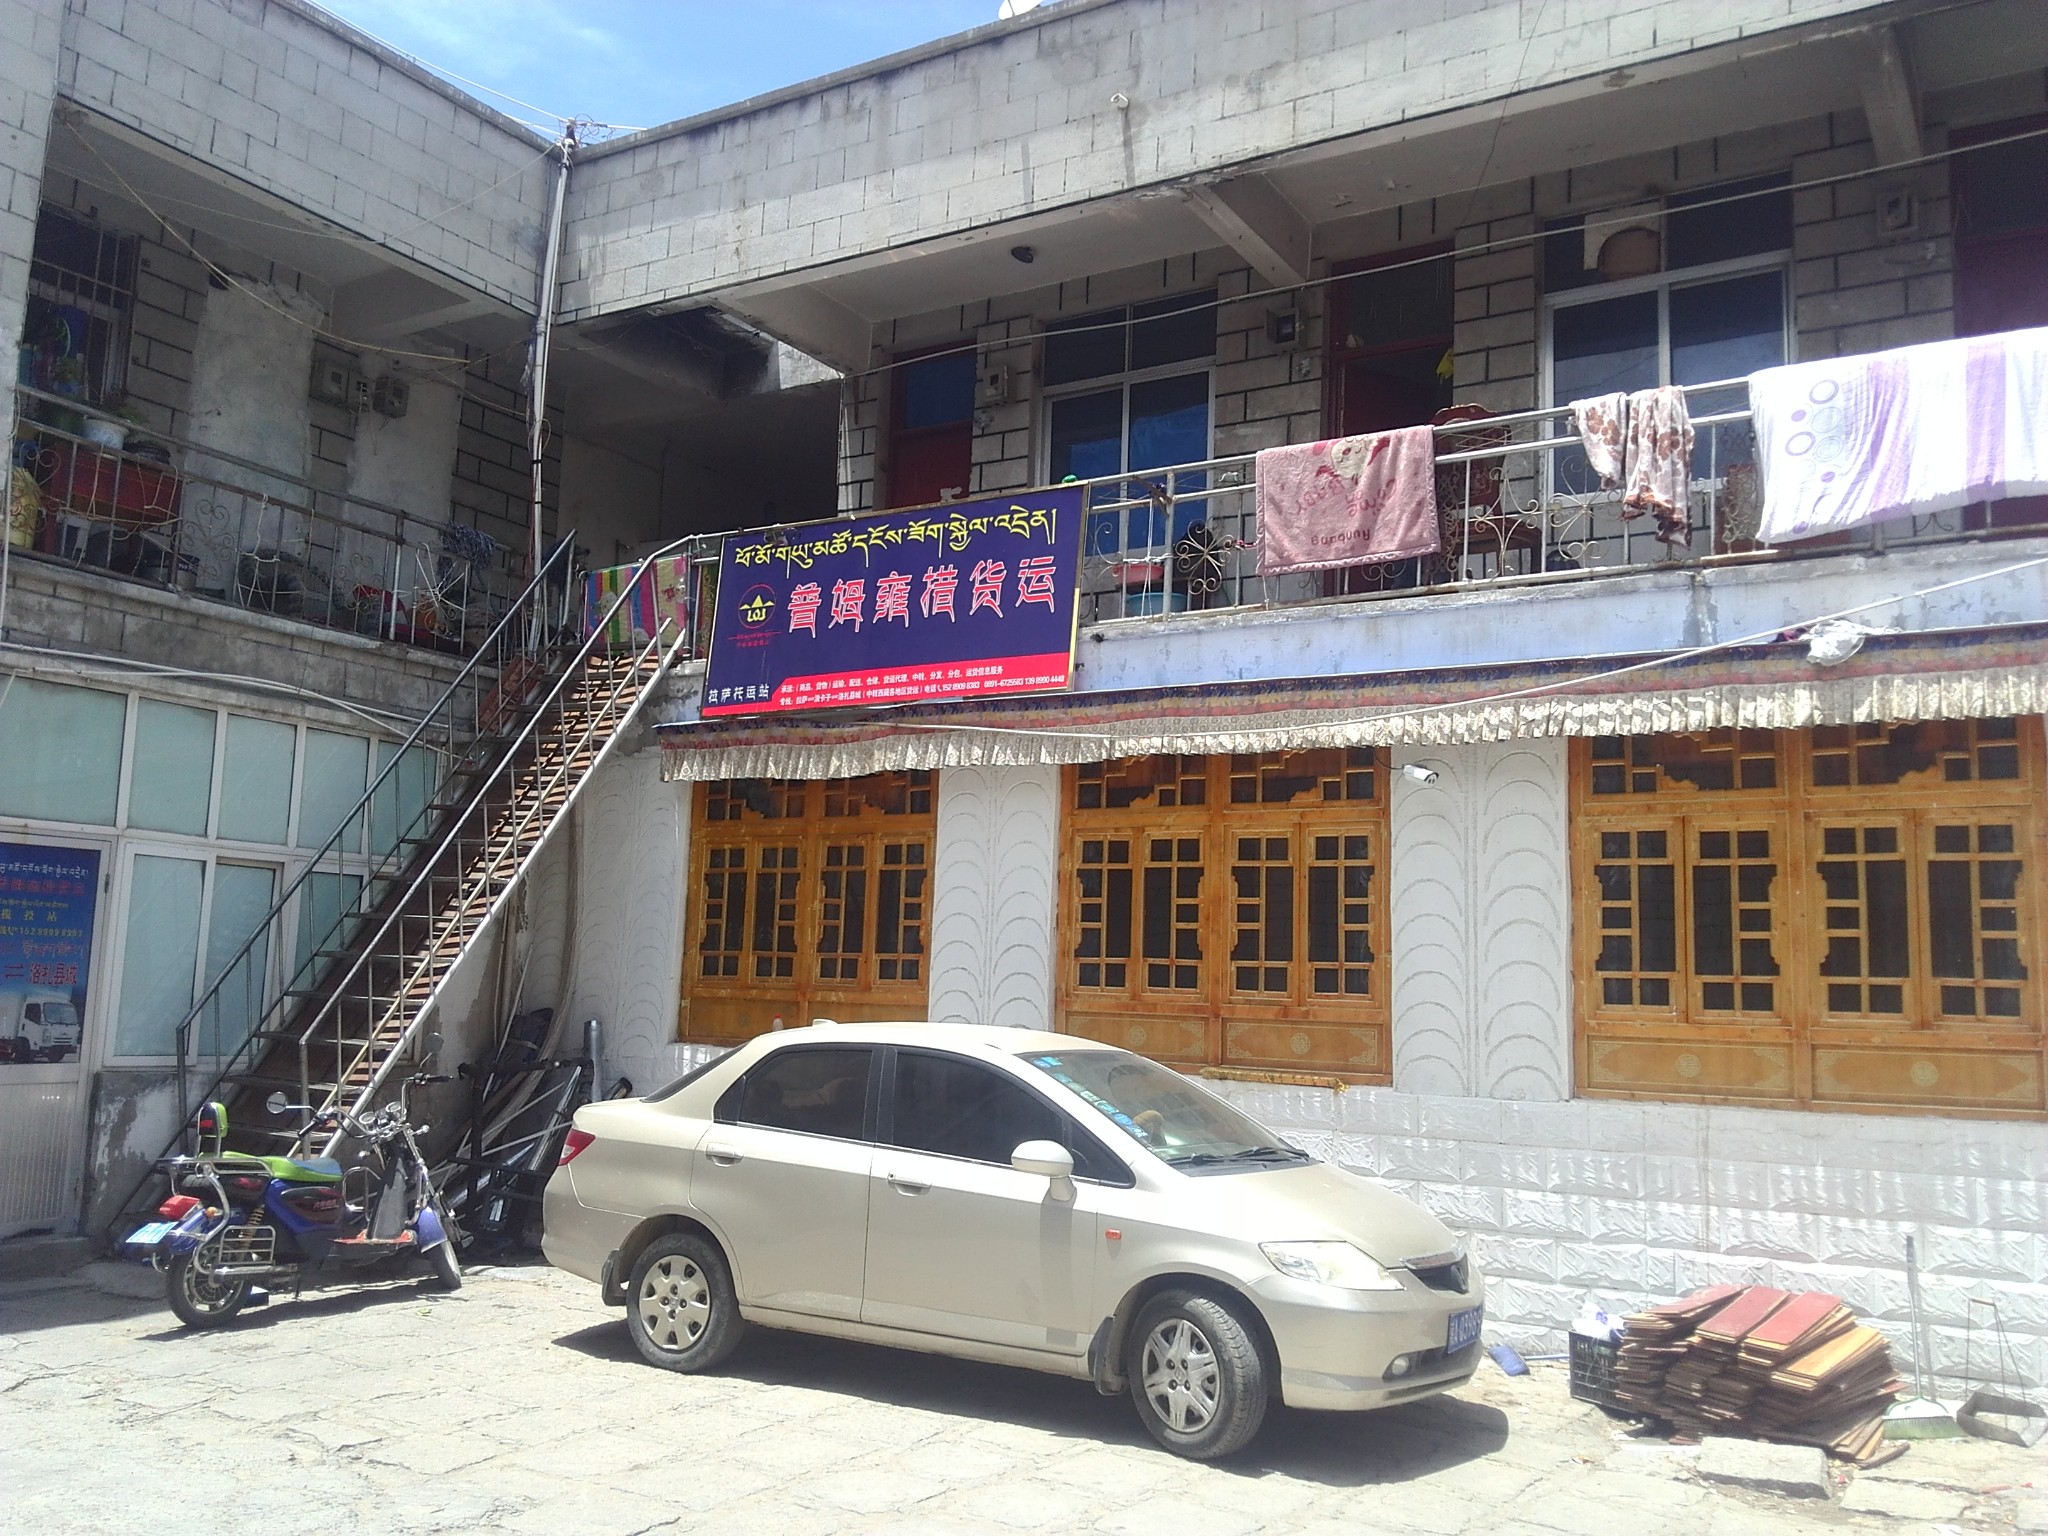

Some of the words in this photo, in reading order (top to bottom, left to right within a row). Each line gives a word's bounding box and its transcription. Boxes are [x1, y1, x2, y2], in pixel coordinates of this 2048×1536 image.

[787, 556, 1056, 638] 普姆雍措货运
[708, 683, 770, 704] 拉萨托运站
[30, 962, 79, 986] 洛扎县城
